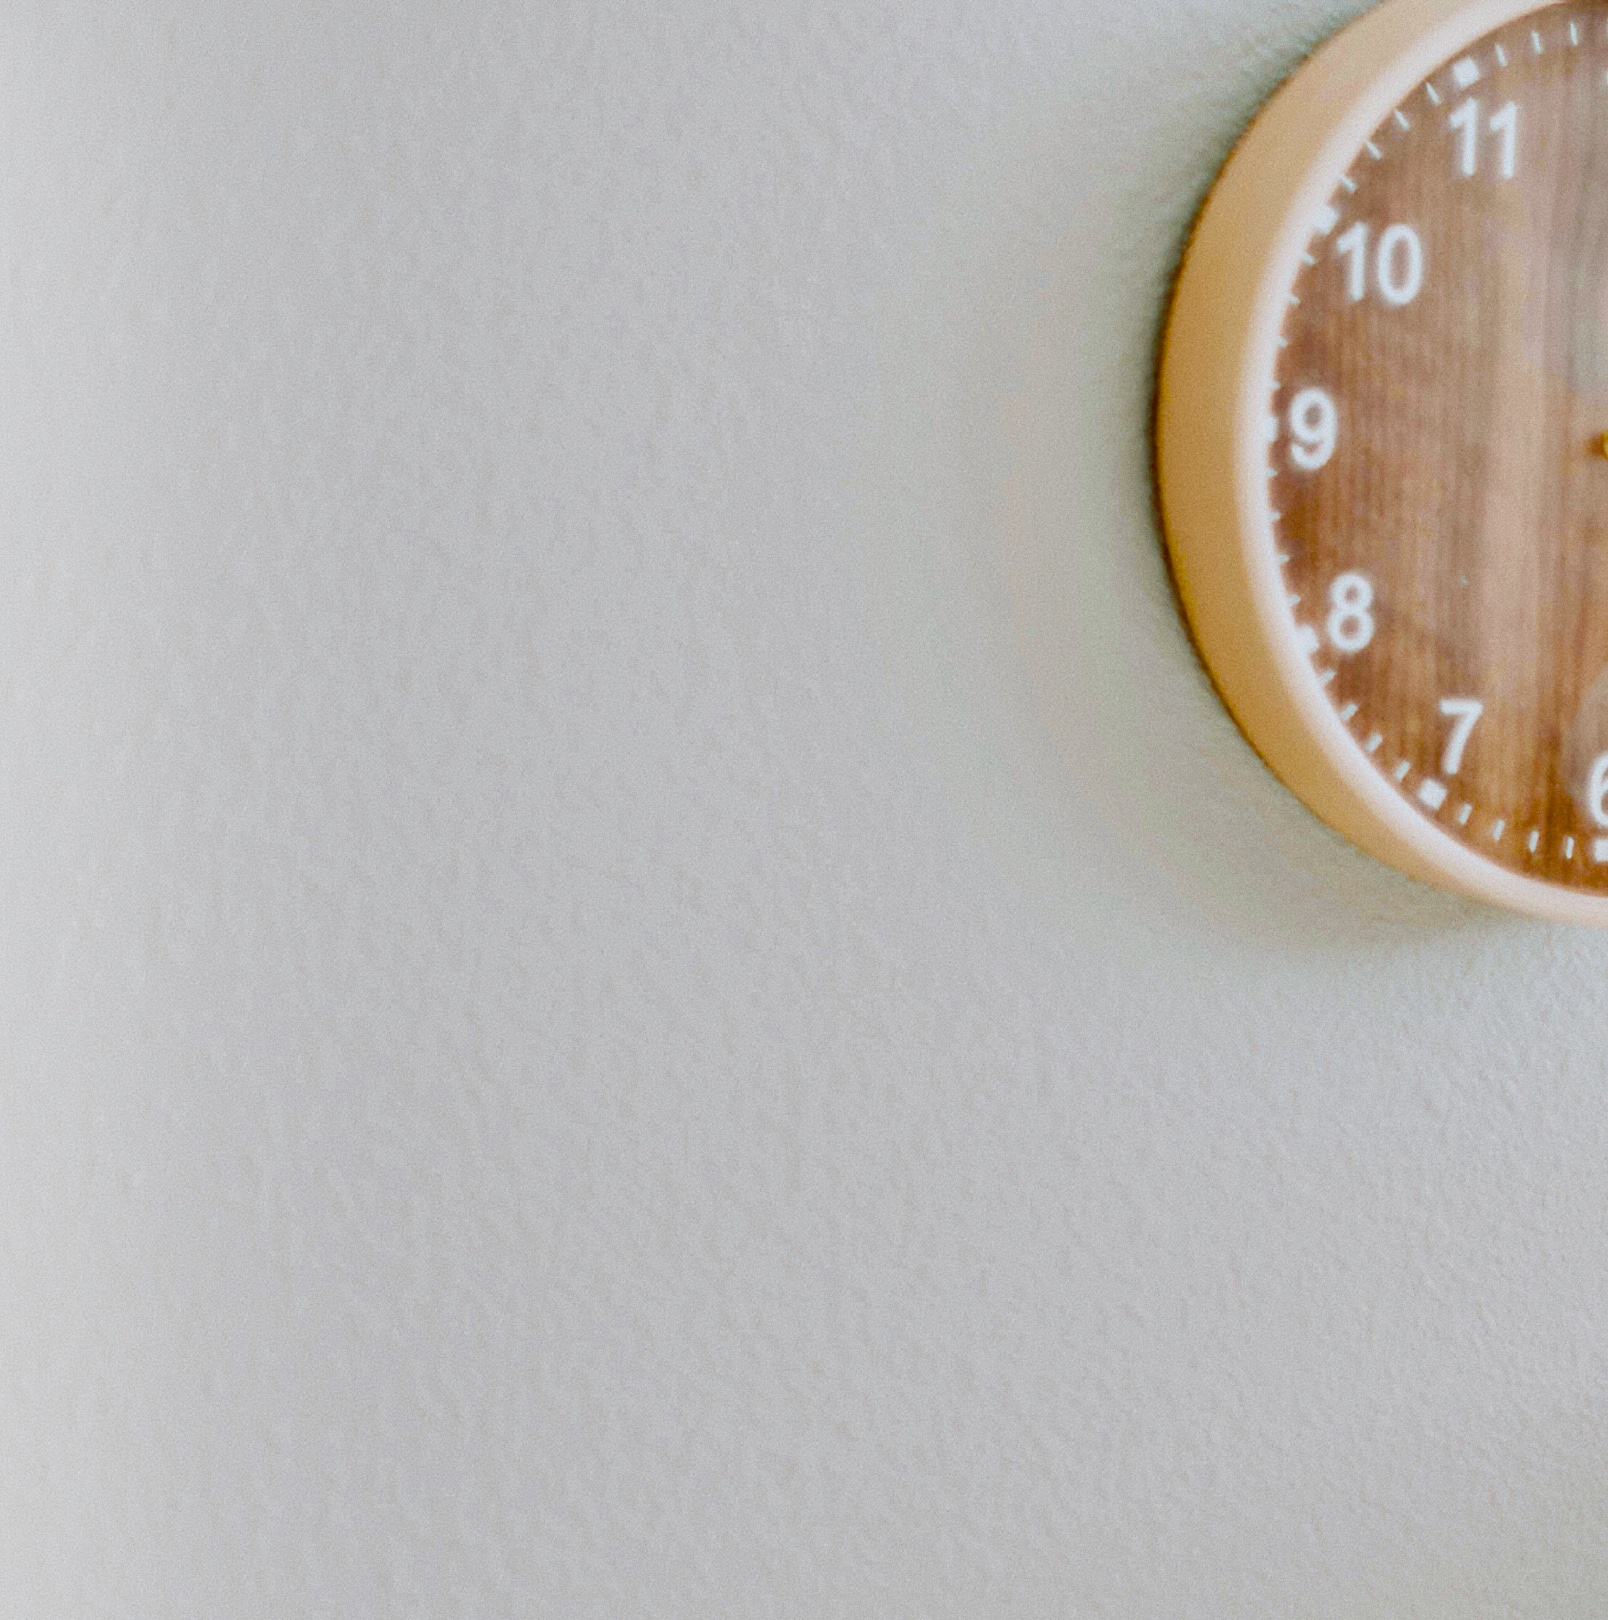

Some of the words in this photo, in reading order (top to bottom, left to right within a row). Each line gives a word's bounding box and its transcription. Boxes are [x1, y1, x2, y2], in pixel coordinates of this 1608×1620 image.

[1450, 97, 1518, 179] 11
[1336, 222, 1424, 306] 10
[1288, 388, 1338, 471] 9
[1326, 573, 1375, 654] 8
[1439, 699, 1482, 775] 7
